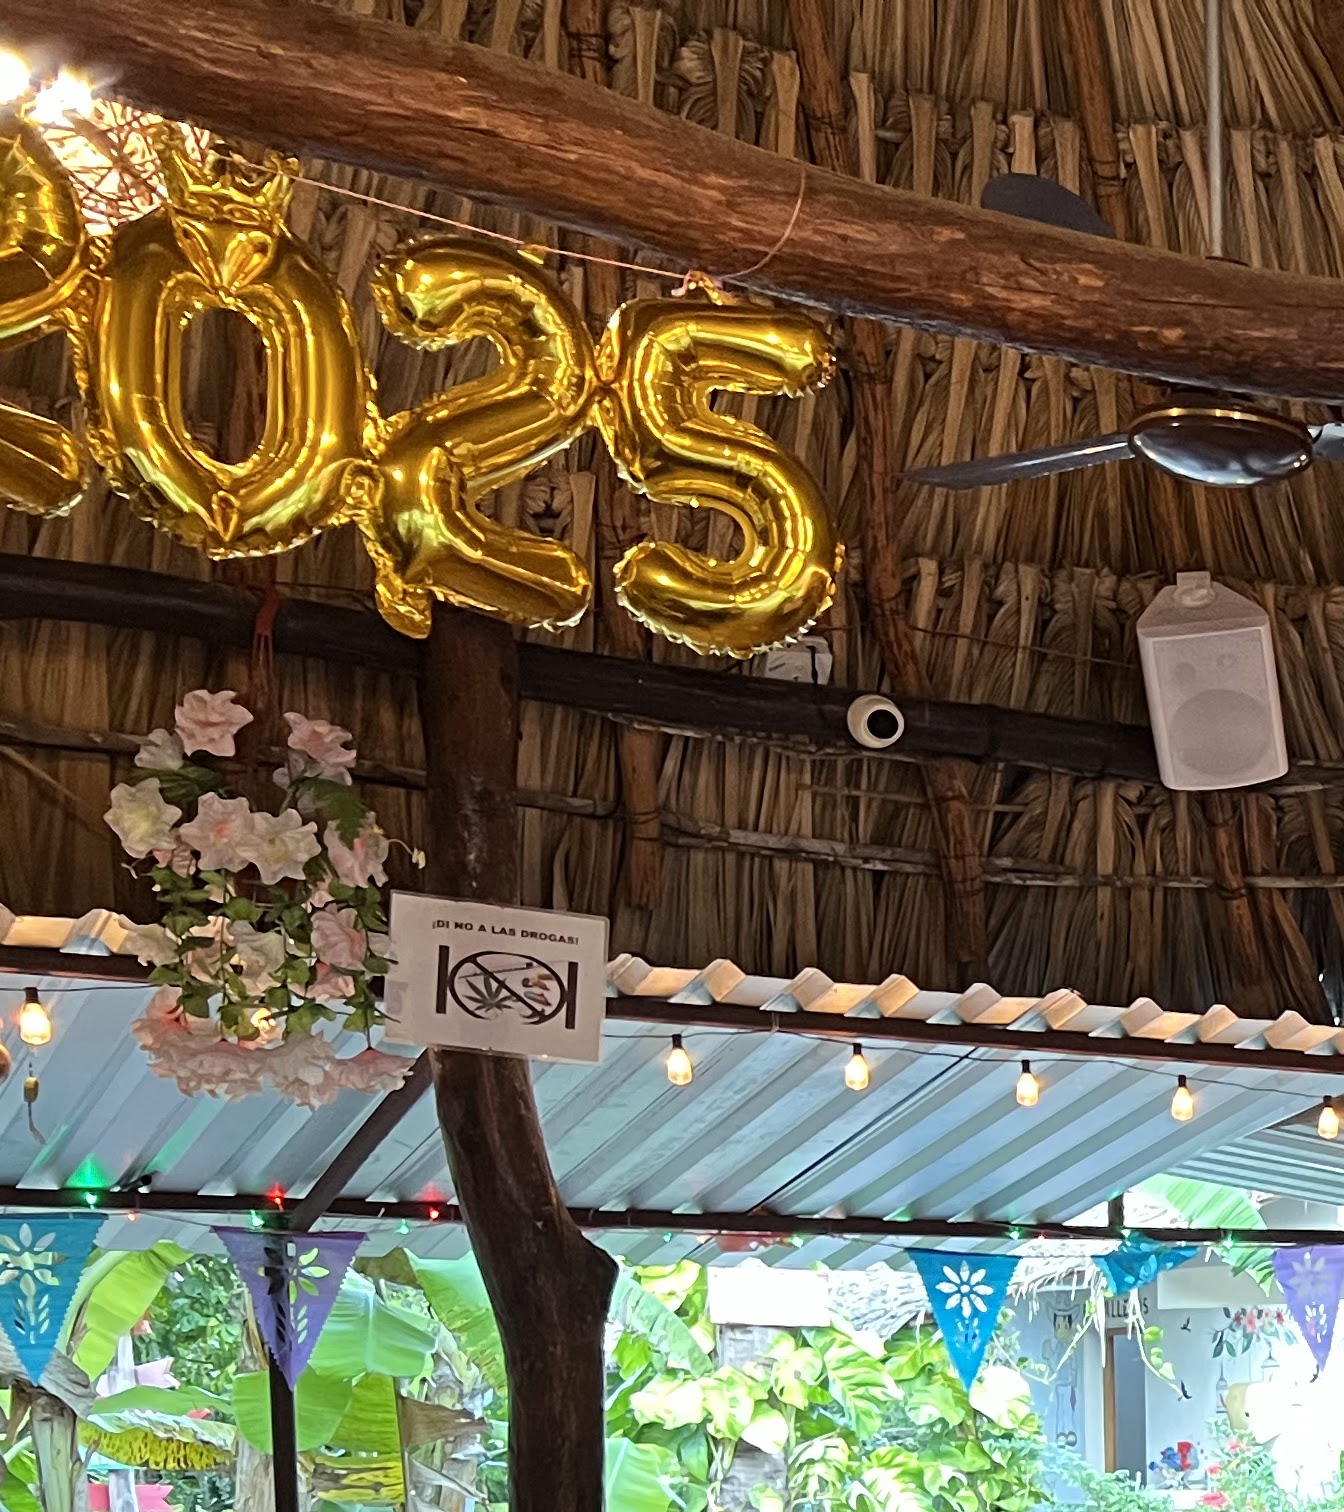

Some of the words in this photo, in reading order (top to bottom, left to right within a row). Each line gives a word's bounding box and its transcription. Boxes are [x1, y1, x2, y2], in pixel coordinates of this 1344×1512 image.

[454, 921, 473, 931] NO
[477, 924, 487, 932] A
[491, 925, 516, 936] LAS
[520, 929, 579, 945] DROGAS!
